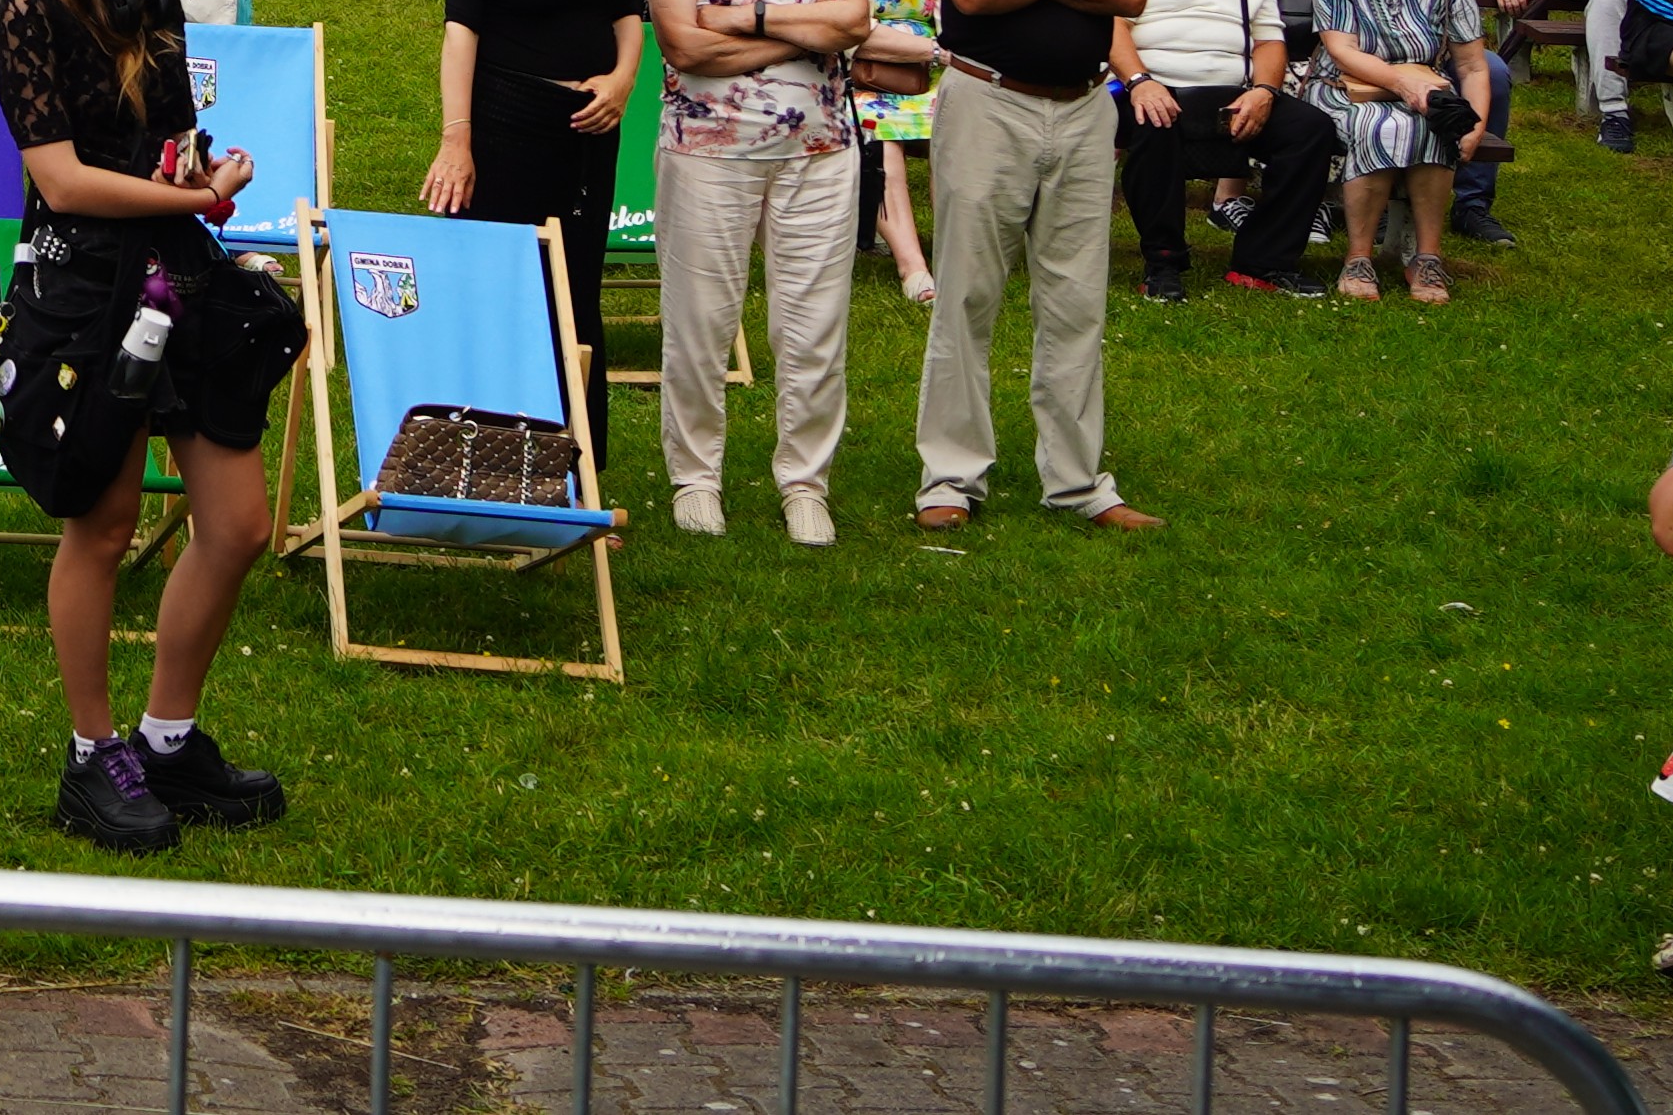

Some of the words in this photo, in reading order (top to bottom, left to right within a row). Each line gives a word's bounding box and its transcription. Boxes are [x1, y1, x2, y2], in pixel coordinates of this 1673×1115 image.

[192, 61, 213, 71] DOBRA
[354, 257, 380, 266] GMINA
[382, 260, 410, 270] DOBRA
